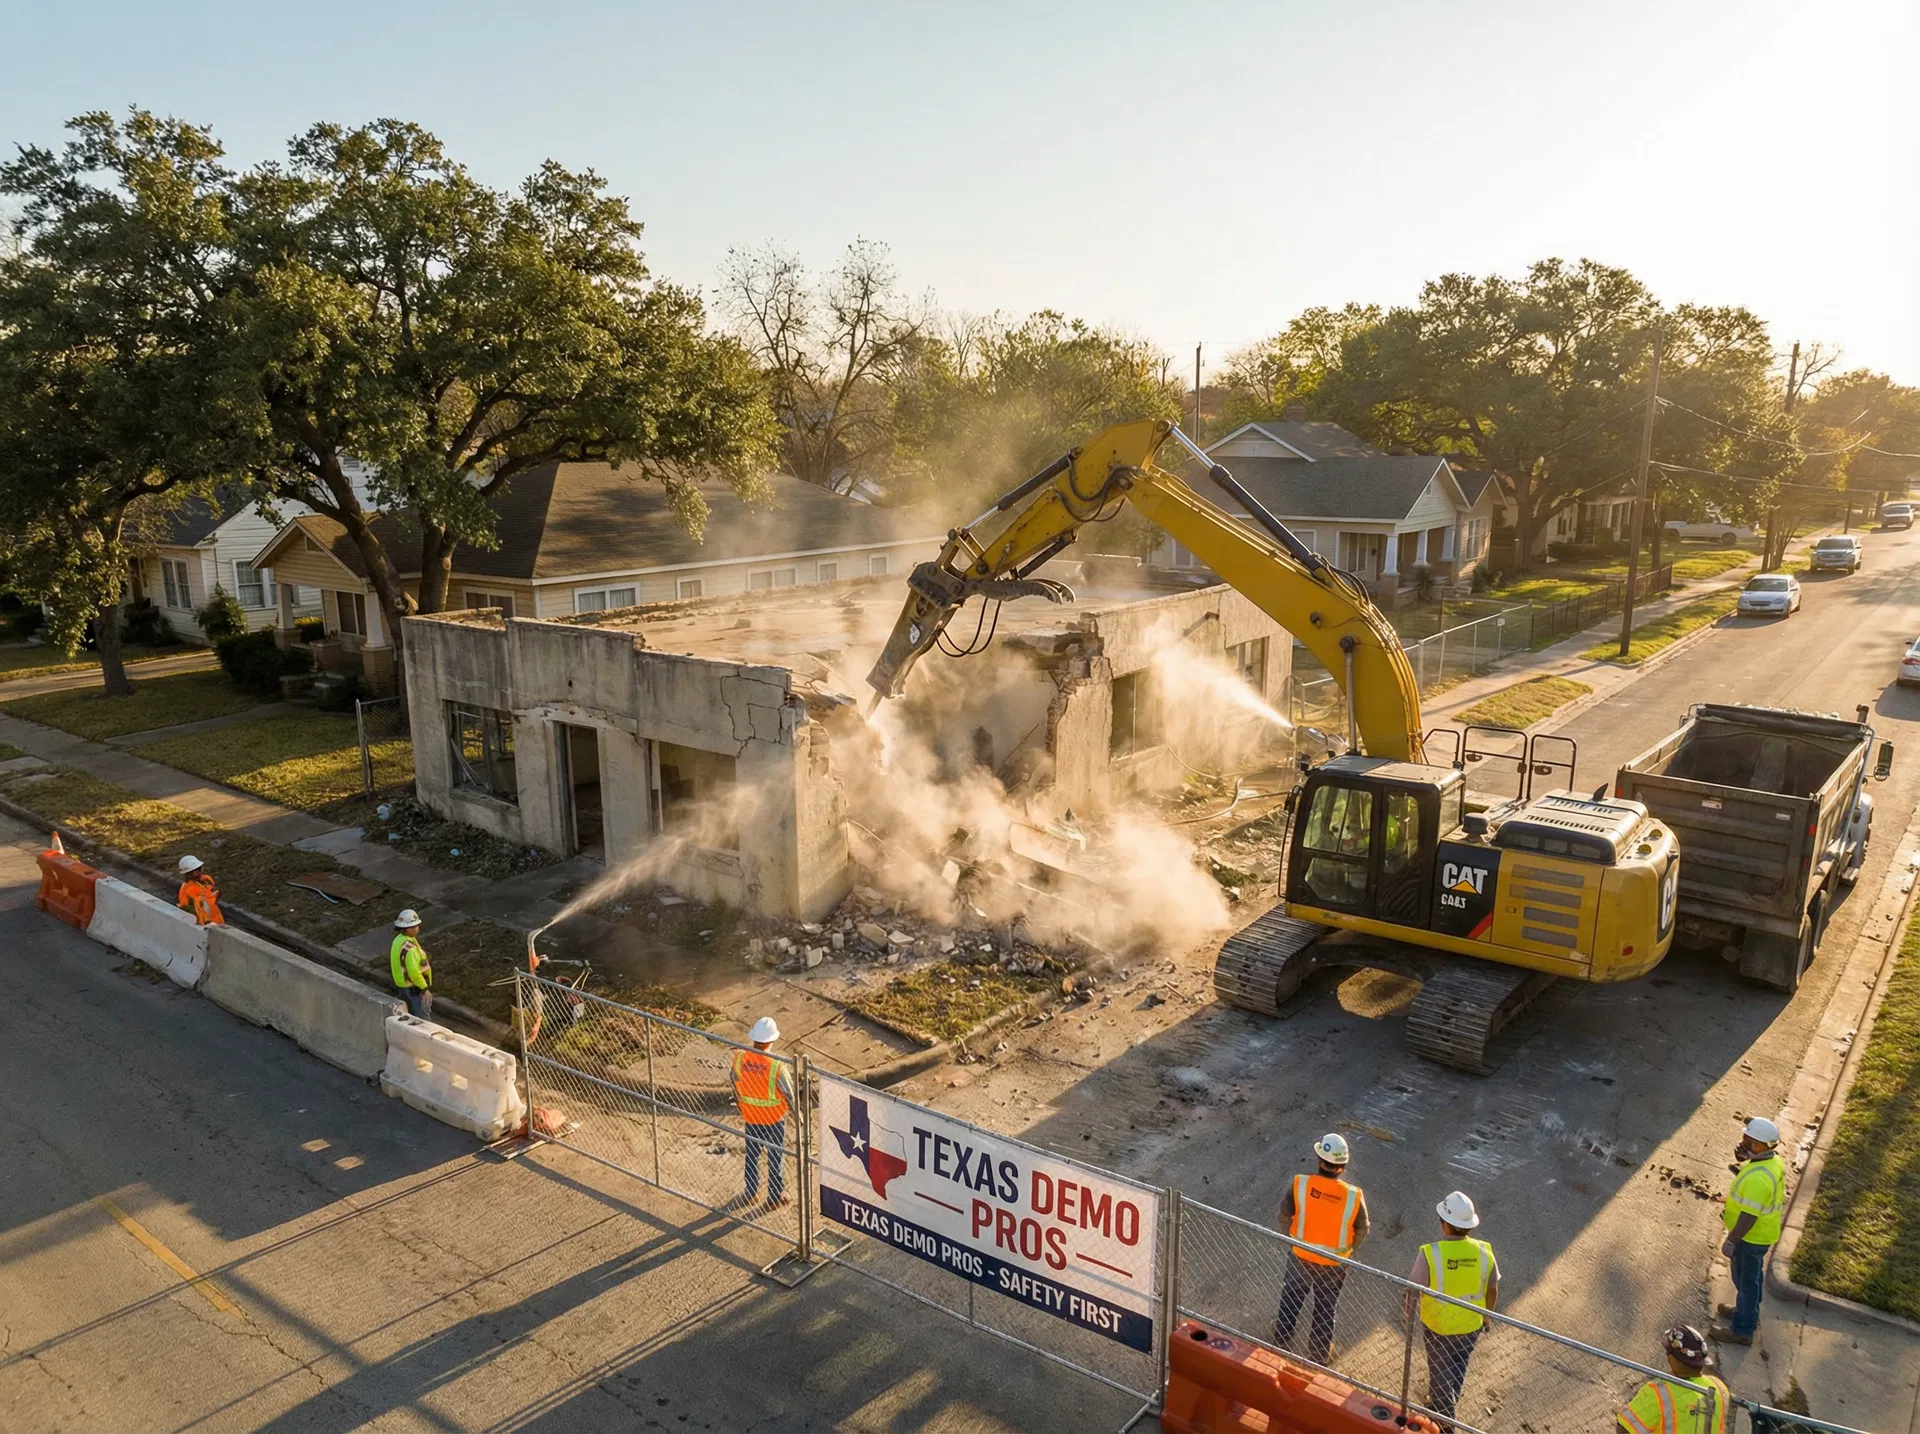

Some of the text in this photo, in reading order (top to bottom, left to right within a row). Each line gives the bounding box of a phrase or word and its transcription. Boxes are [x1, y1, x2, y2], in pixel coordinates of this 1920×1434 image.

[1442, 862, 1488, 895] CAT
[912, 1126, 1140, 1247] TEXAS DEMO
[972, 1197, 1068, 1271] PROS
[842, 1199, 889, 1237] TEXAS
[893, 1221, 936, 1257] DEMO
[941, 1242, 983, 1278] PROS
[1000, 1267, 1064, 1311] SAFETY
[1069, 1294, 1122, 1333] FIRST
